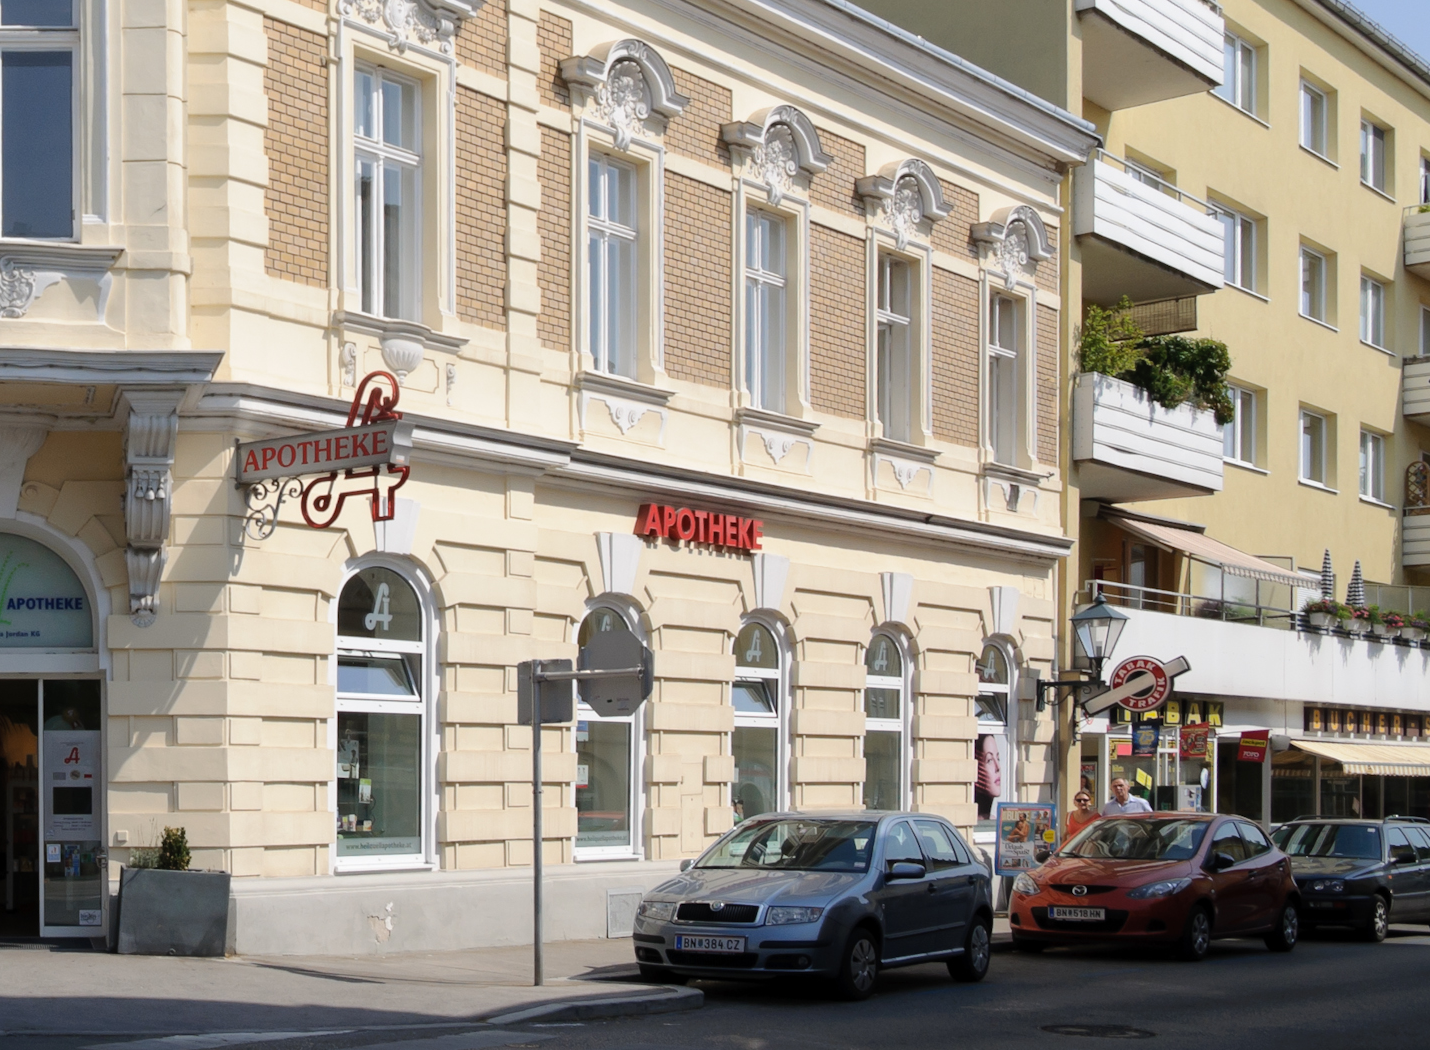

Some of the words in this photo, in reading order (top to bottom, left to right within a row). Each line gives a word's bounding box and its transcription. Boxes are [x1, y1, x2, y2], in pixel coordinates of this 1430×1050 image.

[242, 430, 388, 473] APOTHEKE
[638, 503, 764, 551] APOTHEKE
[6, 597, 83, 611] APOTHEKE
[5, 631, 29, 639] Jordan
[1114, 660, 1157, 684] TABAK
[1129, 676, 1166, 707] TRAFIK
[1056, 908, 1068, 917] BN
[1073, 909, 1089, 918] 518
[1090, 910, 1101, 918] HN
[683, 937, 697, 949] BN
[703, 938, 724, 950] 384
[726, 939, 740, 951] CZ
